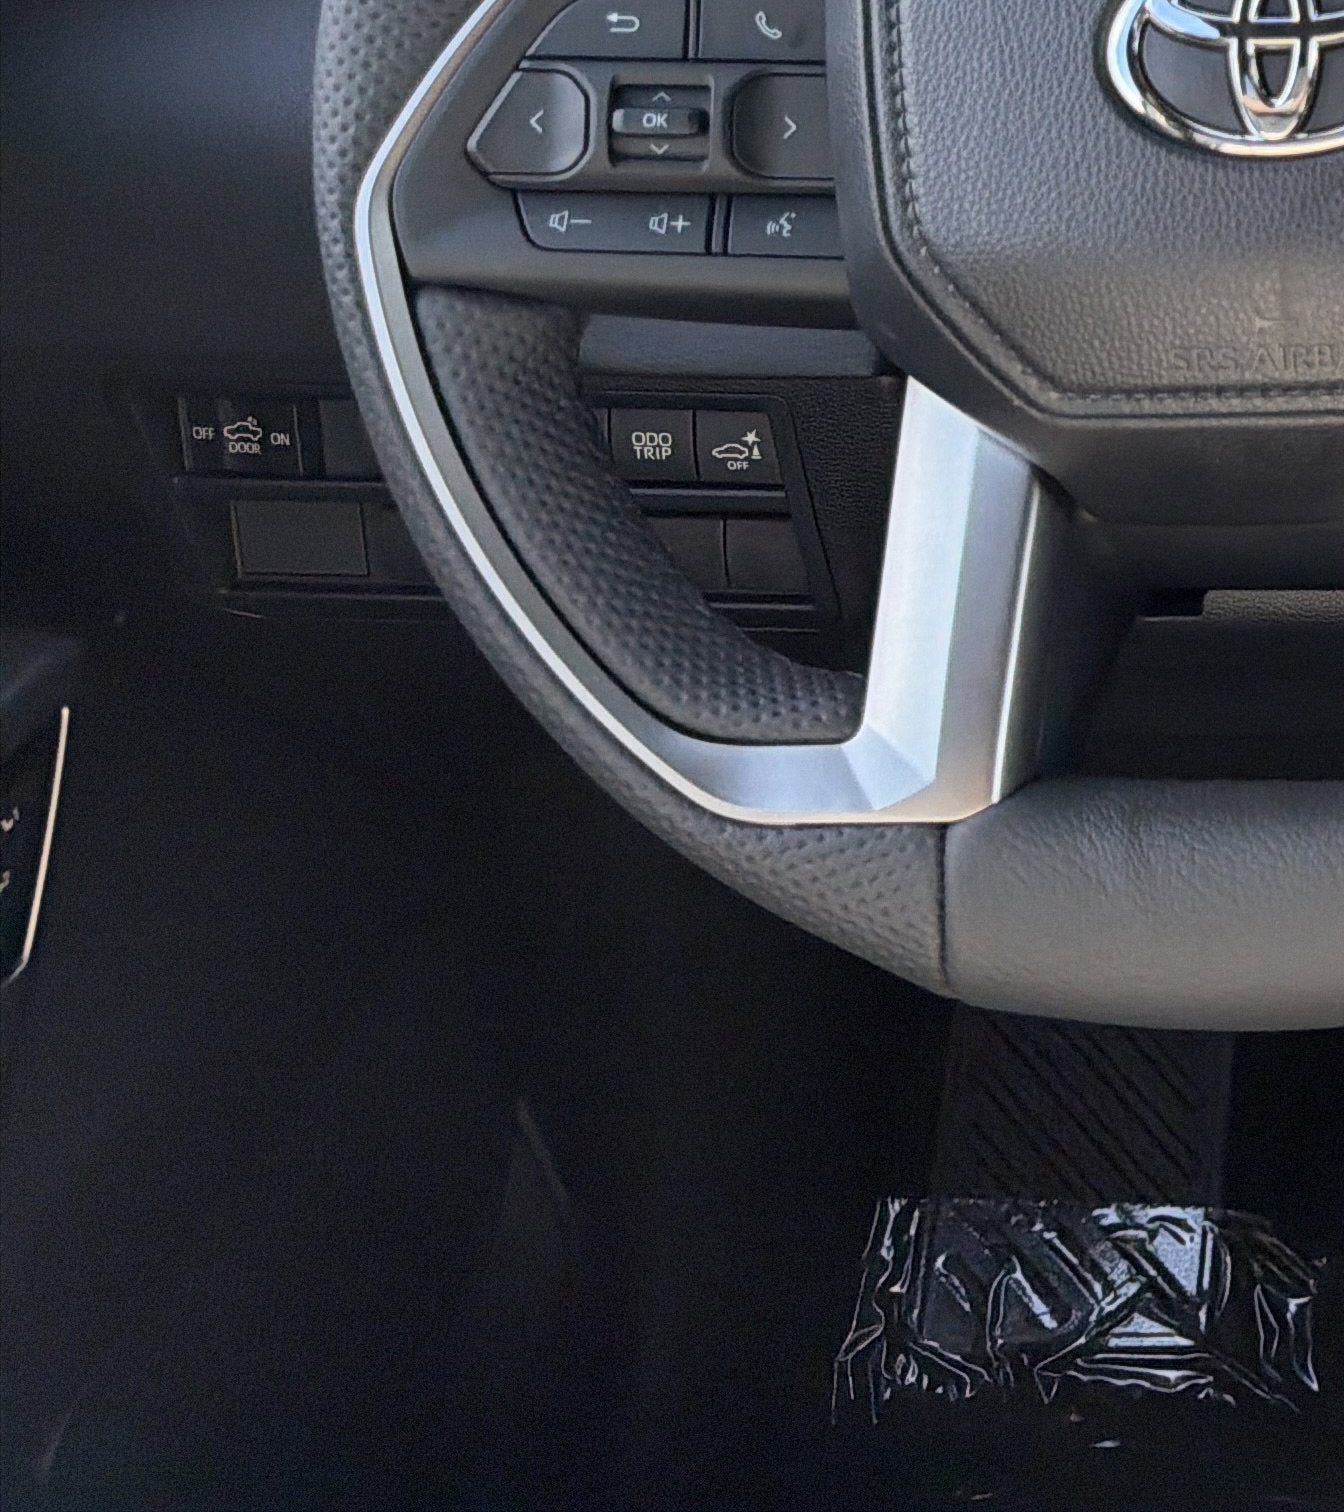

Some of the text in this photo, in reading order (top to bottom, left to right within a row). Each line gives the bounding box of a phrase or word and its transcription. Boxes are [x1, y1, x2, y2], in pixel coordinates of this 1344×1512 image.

[642, 113, 668, 129] OK
[193, 426, 215, 440] OFF
[270, 432, 291, 447] ON
[631, 432, 672, 447] ODO
[229, 442, 262, 455] DOOR
[633, 446, 672, 461] TRIP
[727, 460, 749, 471] OFF
